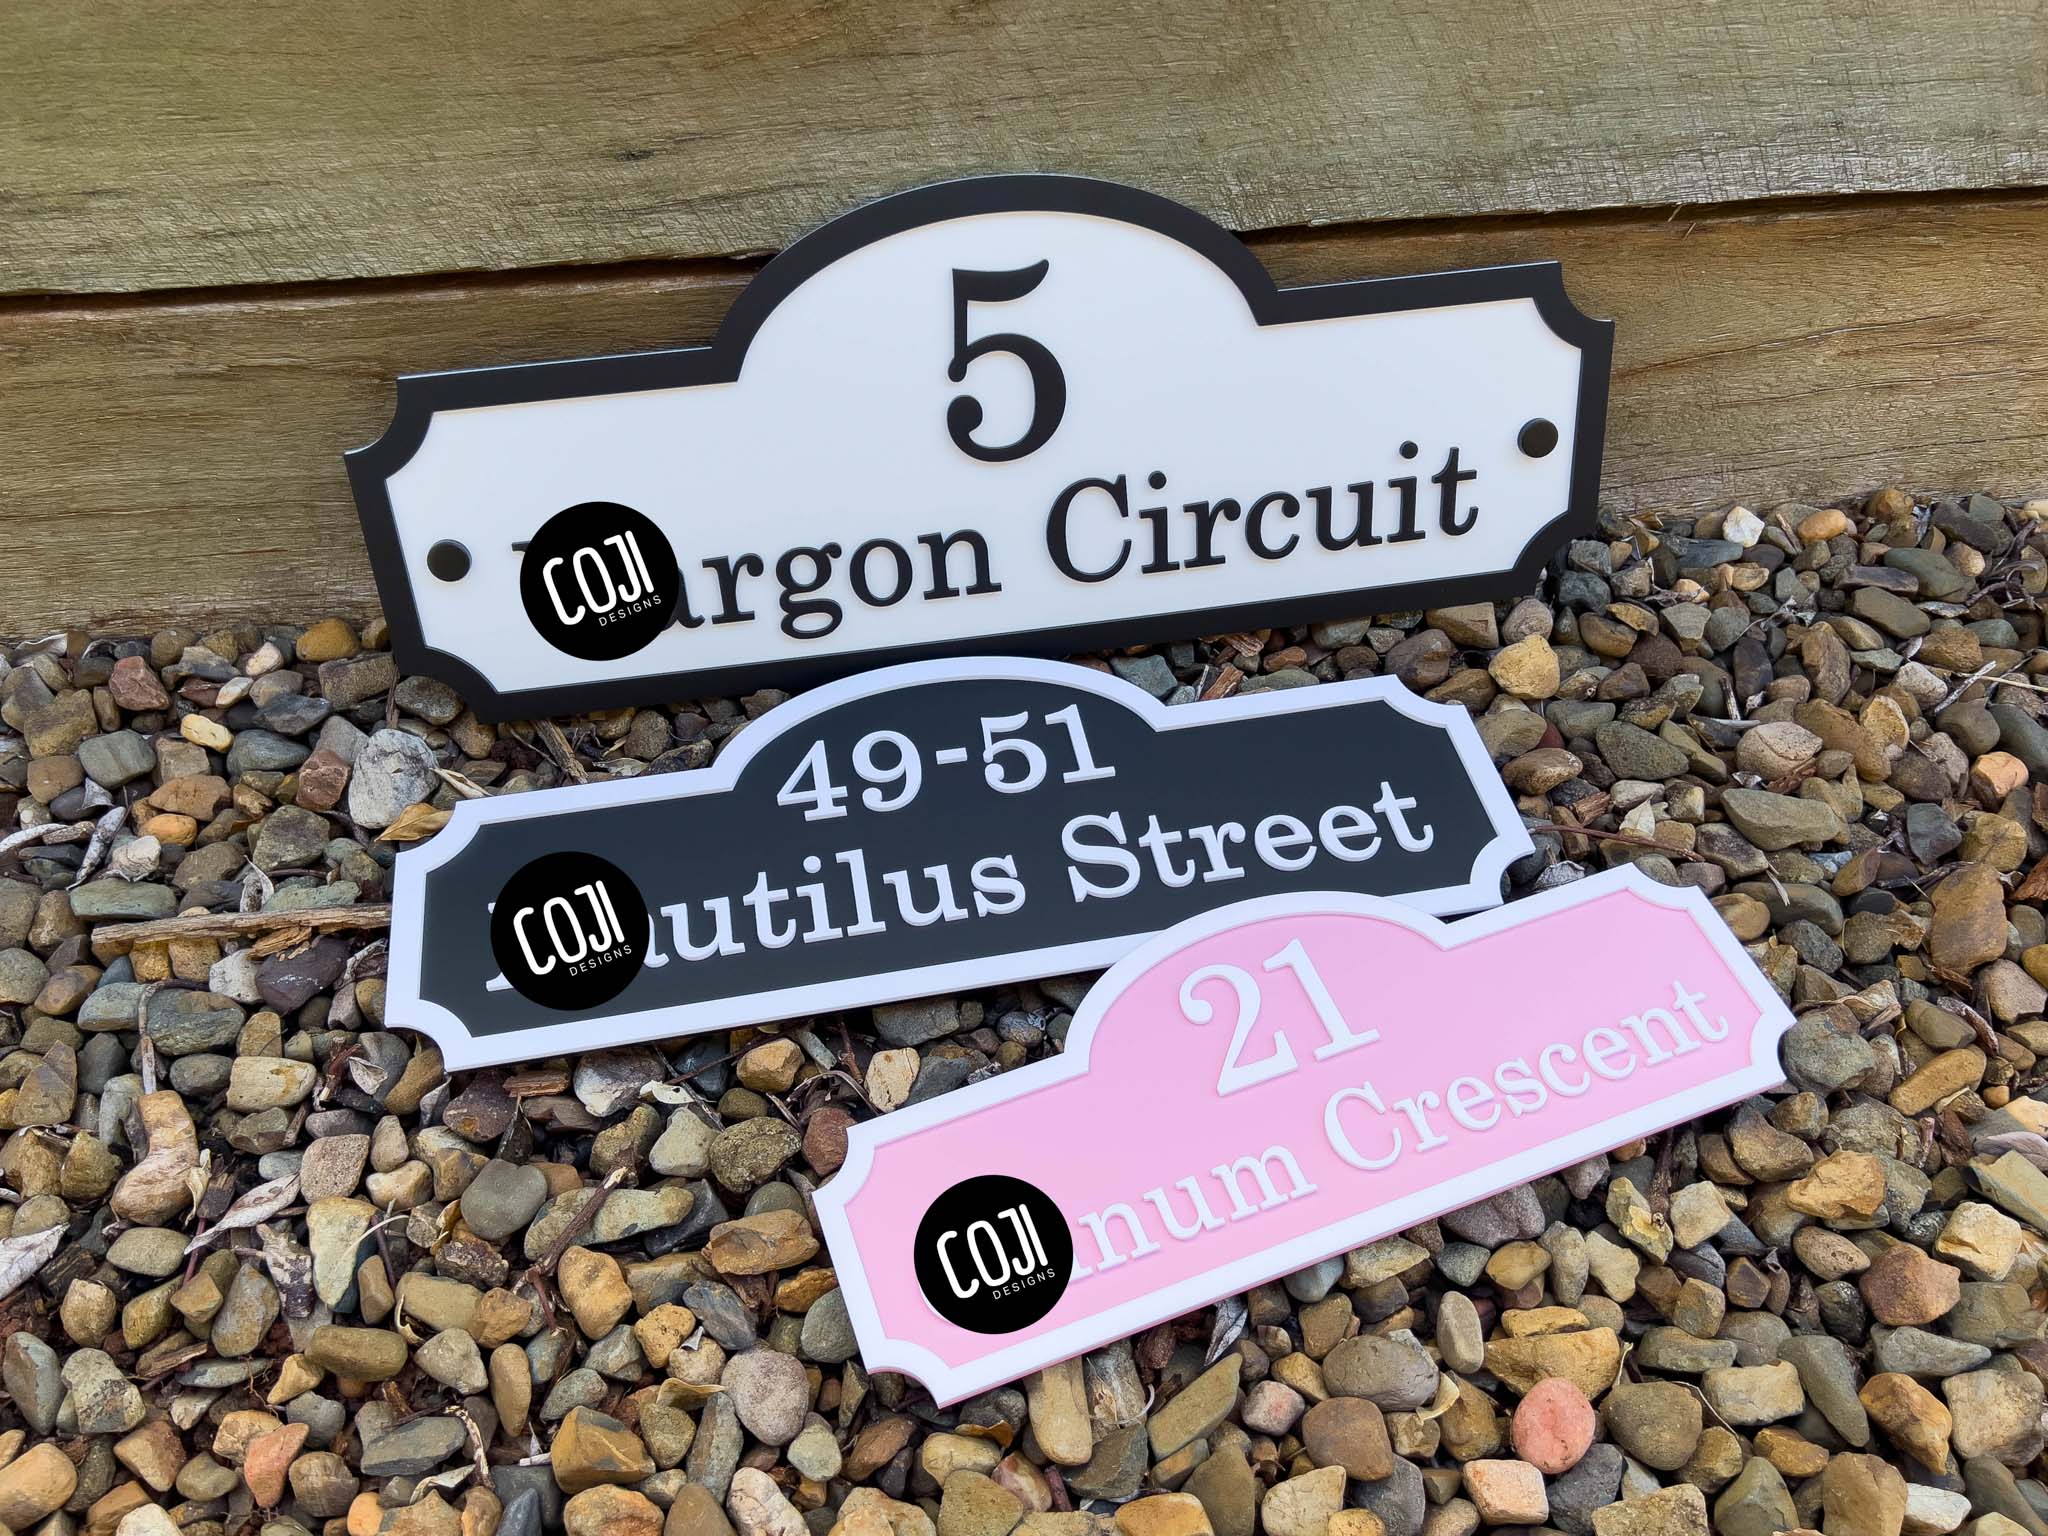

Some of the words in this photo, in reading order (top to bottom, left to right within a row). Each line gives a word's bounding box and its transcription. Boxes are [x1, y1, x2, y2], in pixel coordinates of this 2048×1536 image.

[945, 258, 1068, 464] 5
[1045, 440, 1480, 585] Circuit
[776, 703, 1116, 823] 49-51
[485, 848, 1027, 992] utilus
[1060, 781, 1435, 903] Street
[1178, 938, 1380, 1098] 21
[1323, 980, 1729, 1172] Crescent
